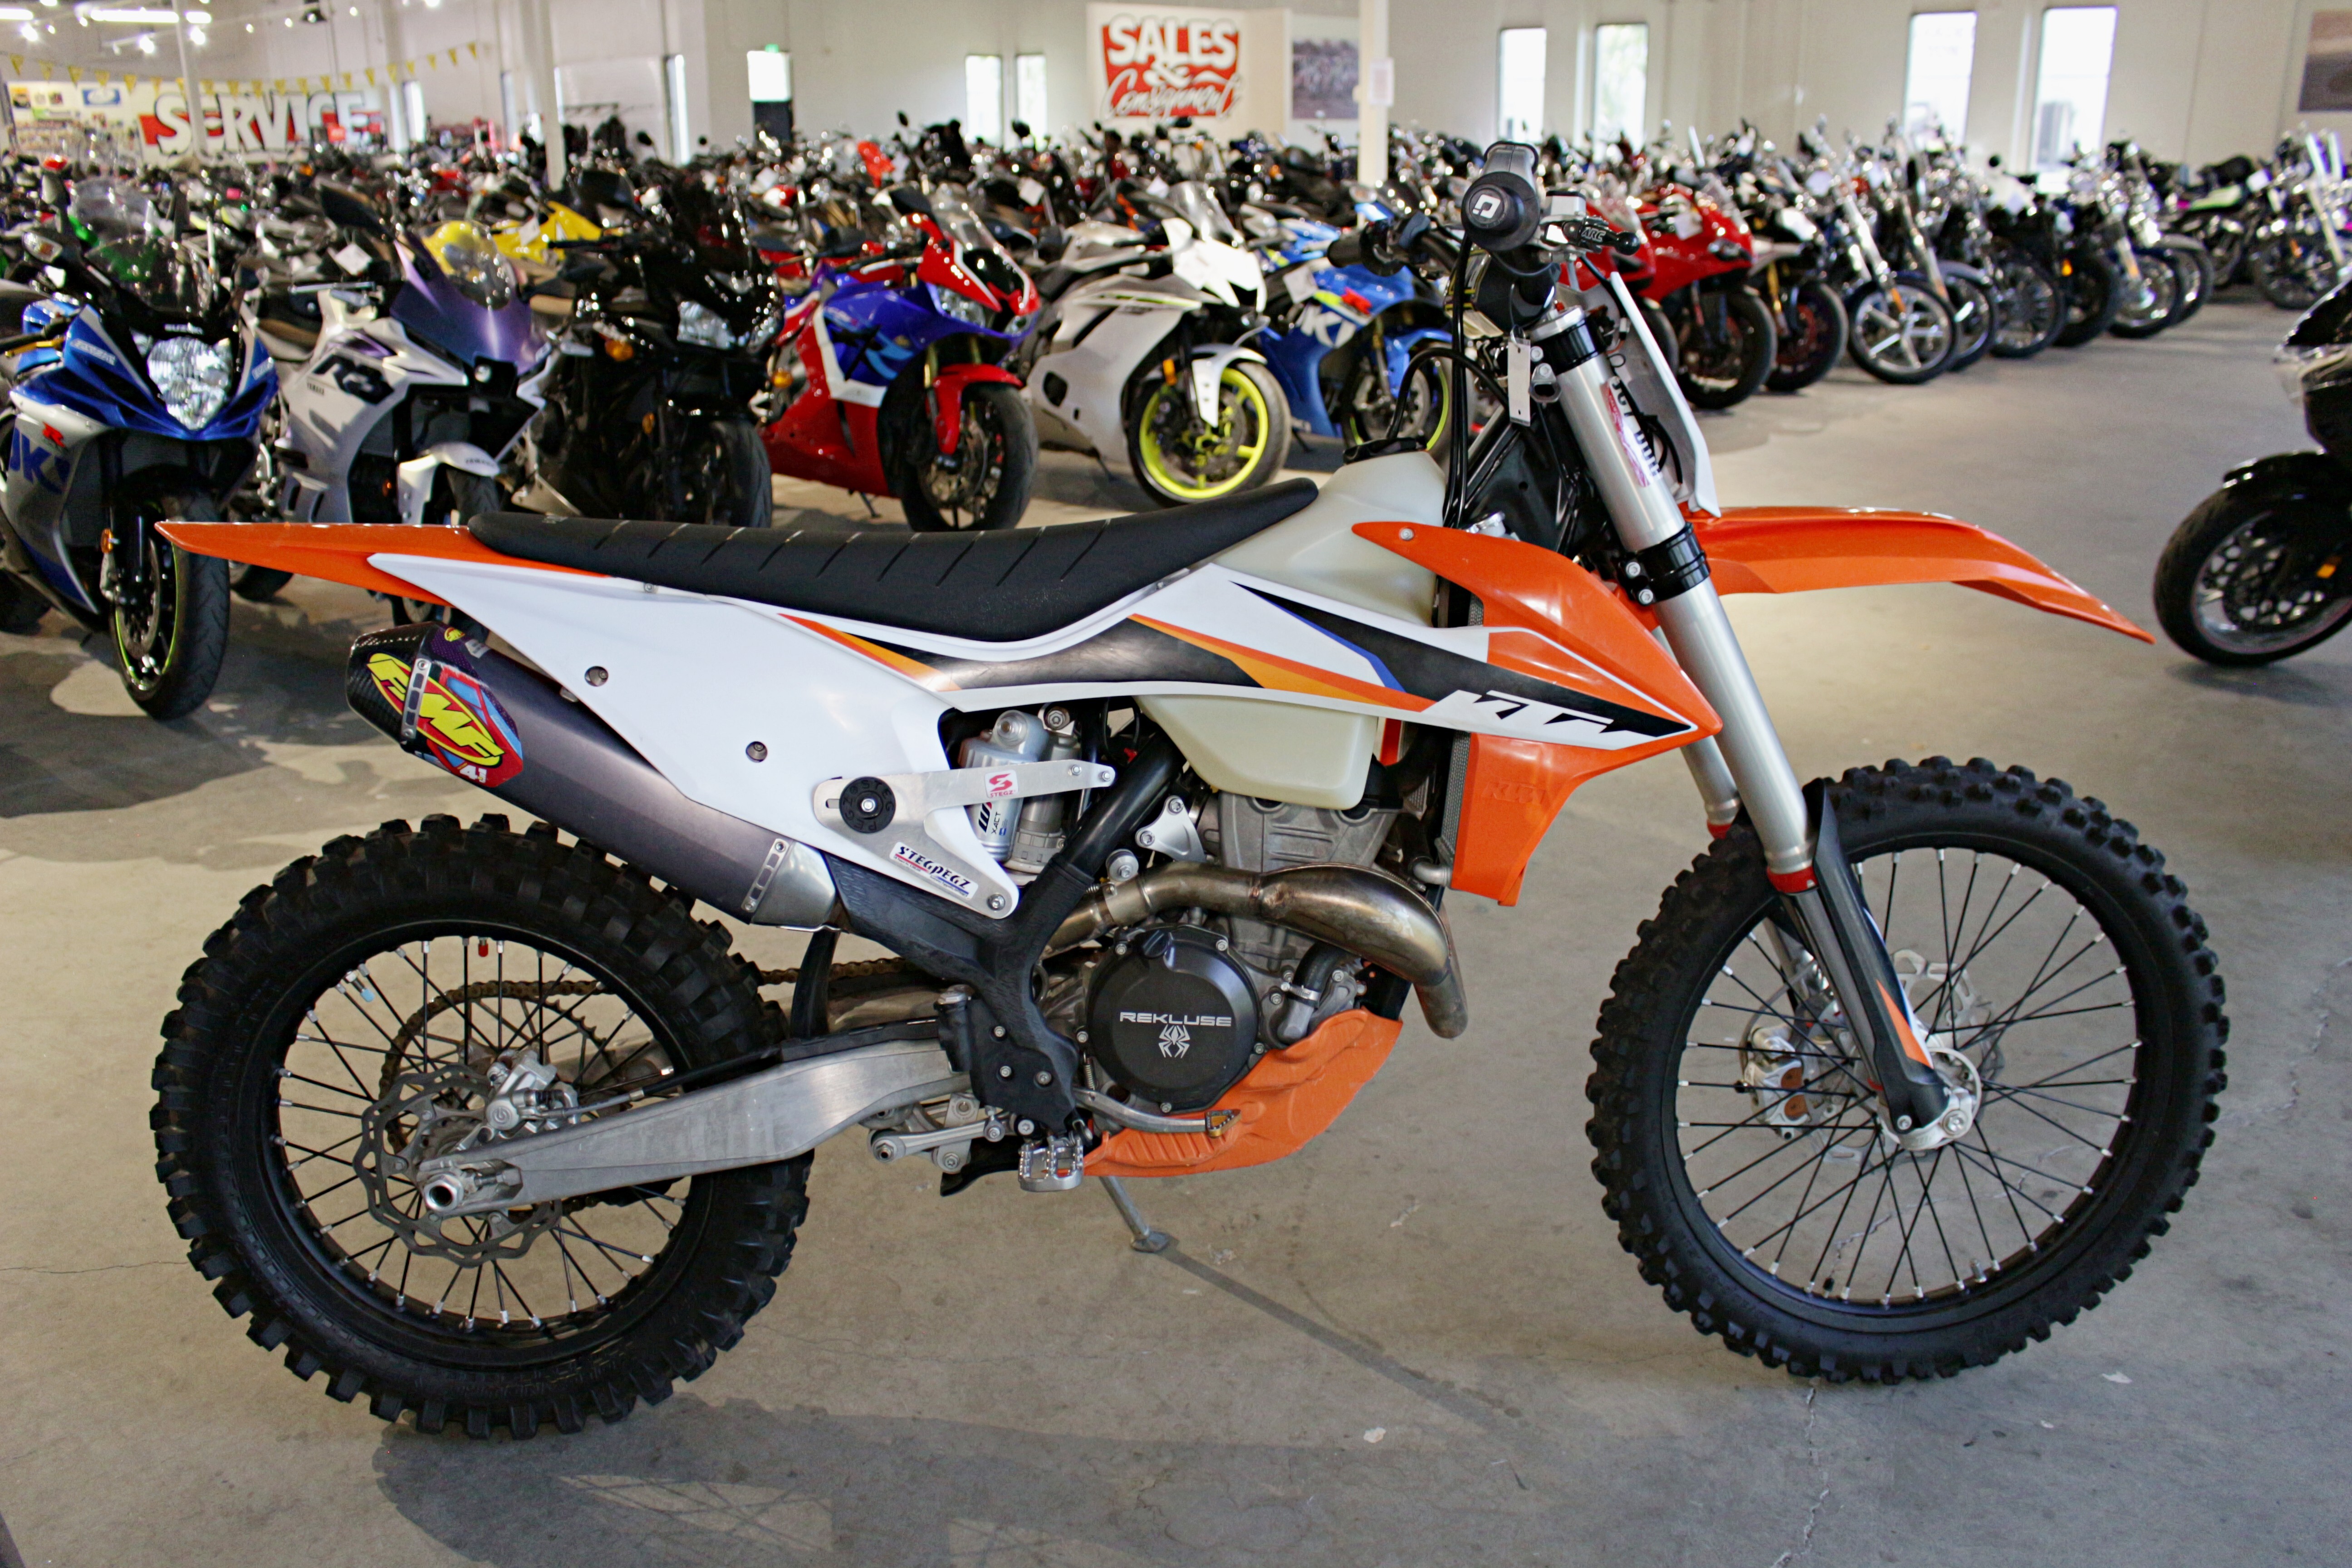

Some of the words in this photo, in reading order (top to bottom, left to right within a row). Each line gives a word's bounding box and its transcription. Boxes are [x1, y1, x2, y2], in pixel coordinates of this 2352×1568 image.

[1108, 14, 1238, 69] SALES
[1143, 62, 1195, 89] &
[1100, 68, 1242, 122] Consignment
[155, 92, 366, 156] SERVICE
[1581, 227, 1607, 242] ARC
[367, 658, 505, 759] FMF
[1481, 780, 1547, 806] KTM
[991, 811, 1001, 834] XACT
[898, 846, 971, 889] STEGPEGZ
[1120, 1011, 1232, 1027] REKLUSE
